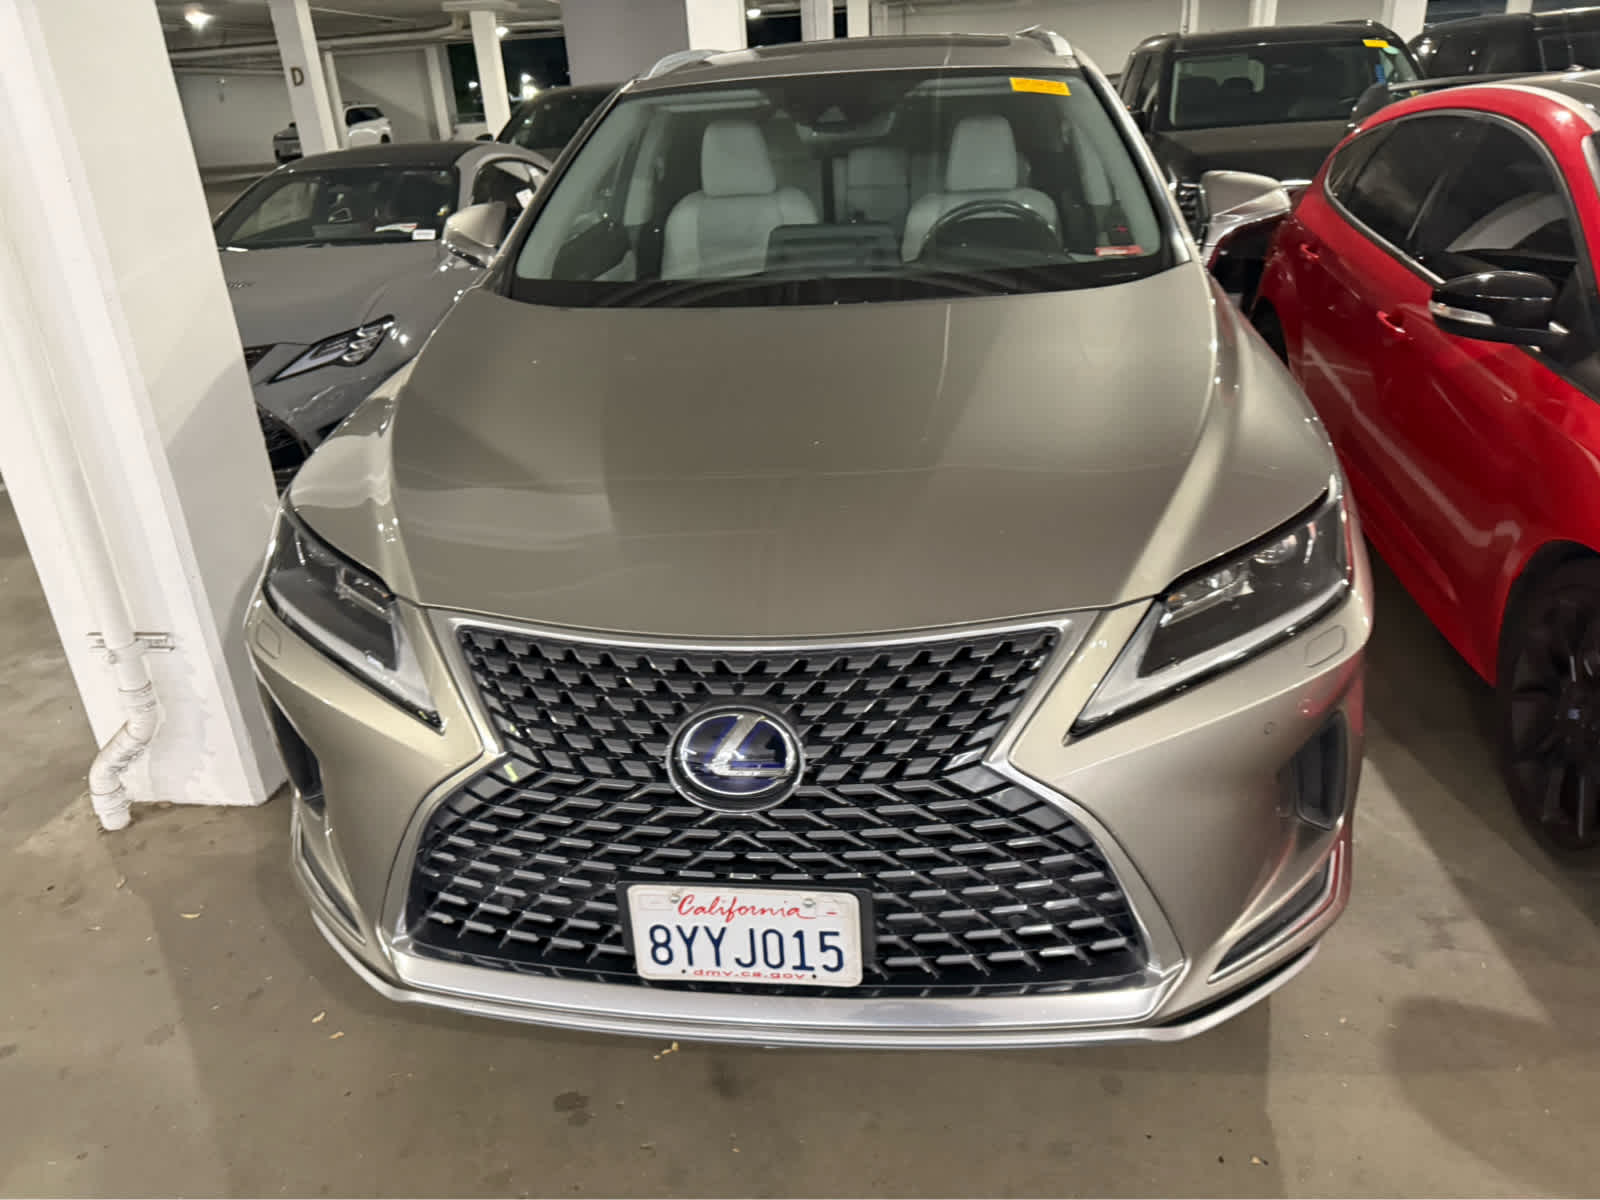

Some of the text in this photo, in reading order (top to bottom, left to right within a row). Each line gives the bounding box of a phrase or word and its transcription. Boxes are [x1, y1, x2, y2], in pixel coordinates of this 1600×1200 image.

[290, 66, 305, 87] D
[677, 894, 817, 923] California
[648, 924, 845, 973] 8YYJ015
[693, 968, 806, 980] dmv.ca.gov
